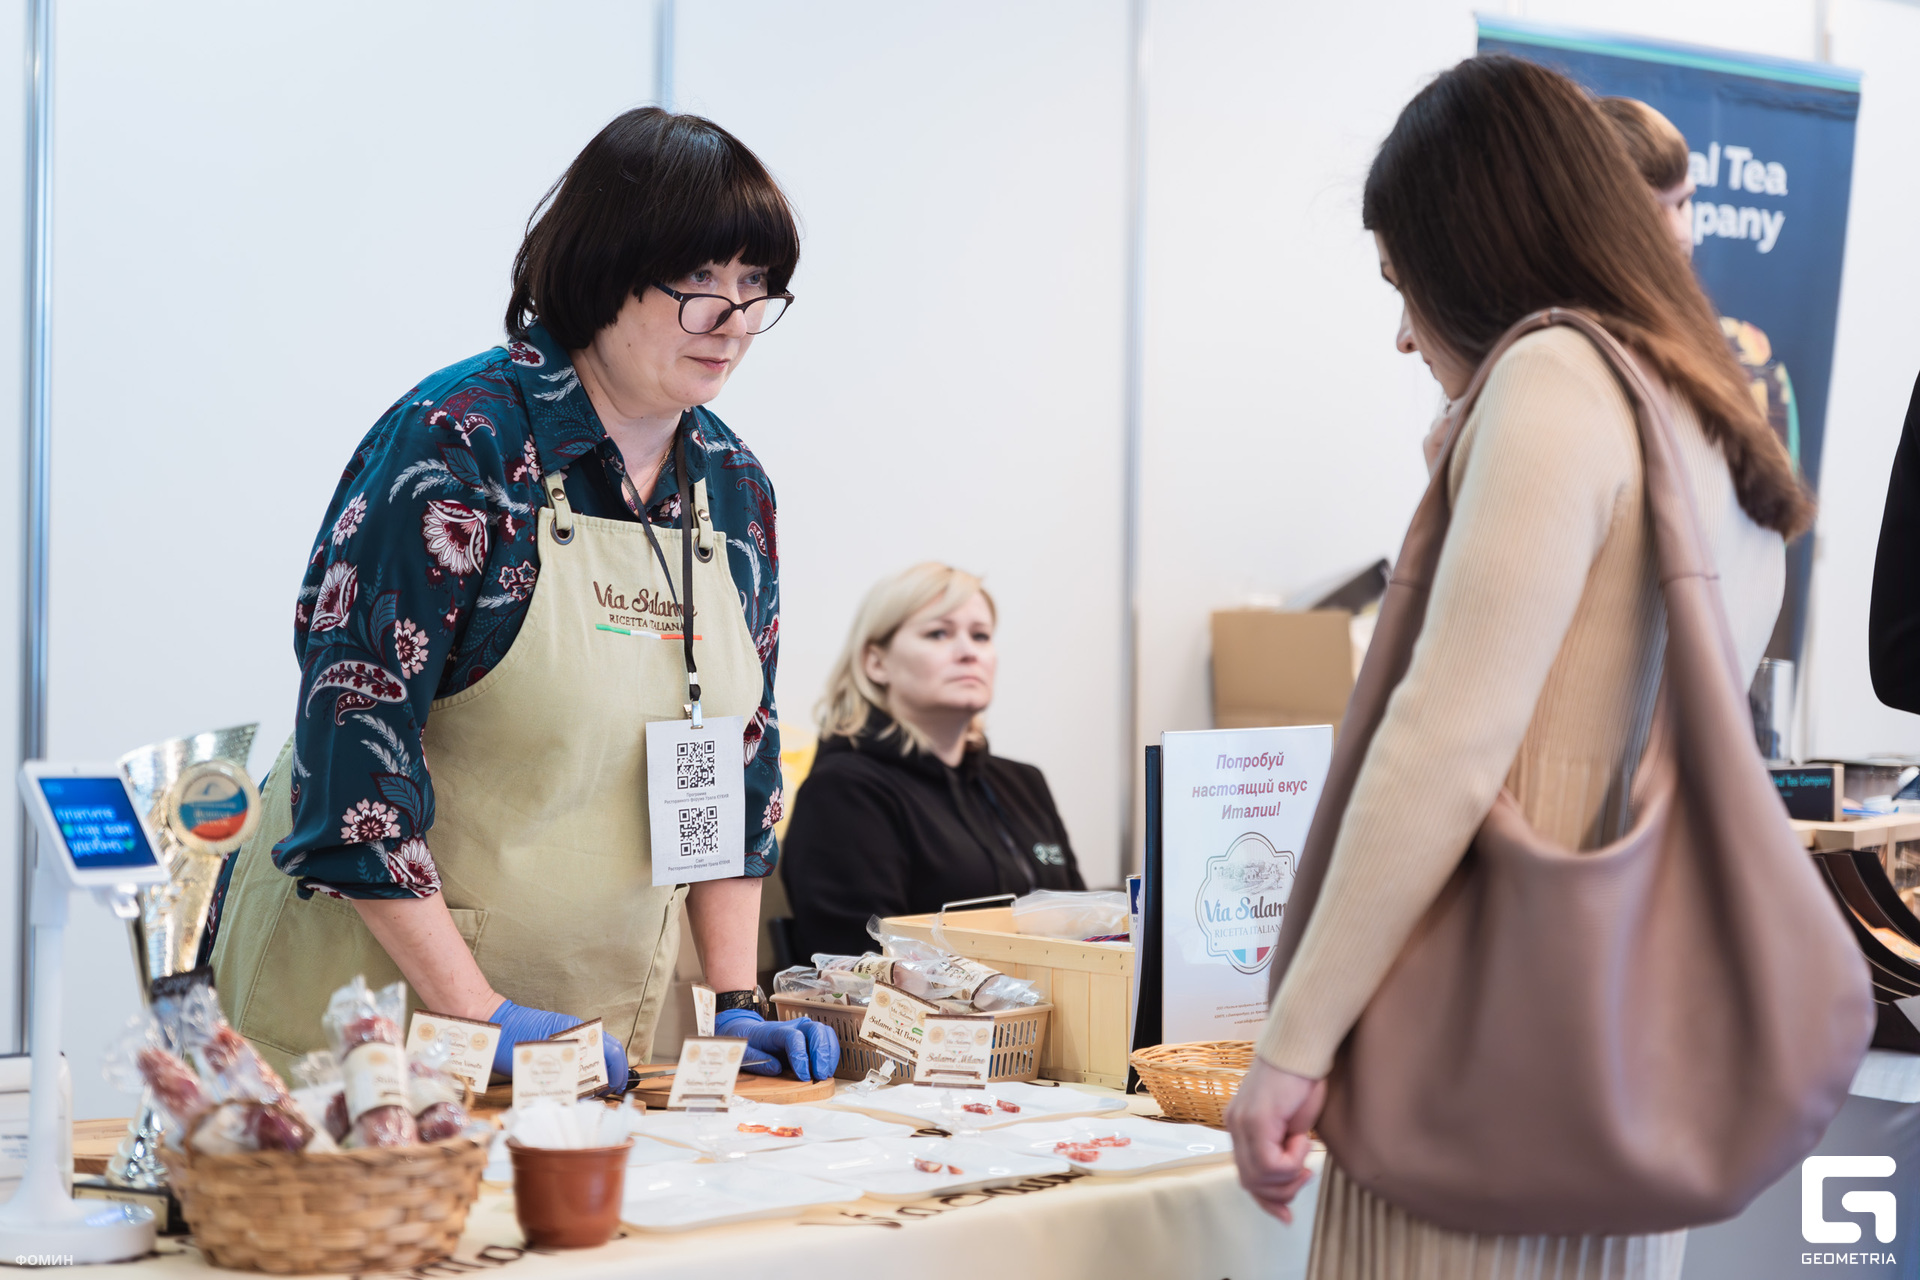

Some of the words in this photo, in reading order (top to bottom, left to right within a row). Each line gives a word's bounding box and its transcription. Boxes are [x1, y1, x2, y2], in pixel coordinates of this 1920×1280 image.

[1689, 141, 1720, 188] al
[1723, 144, 1789, 196] Tea
[1693, 201, 1786, 254] pany
[593, 581, 629, 610] Via
[609, 613, 648, 628] RICETTA
[1216, 751, 1285, 771] Попробуй
[1192, 778, 1274, 798] настоящий
[1278, 780, 1308, 796] вкус
[1221, 801, 1281, 820] Италии!
[1204, 899, 1232, 923] Via
[1235, 896, 1287, 920] Salam
[1214, 927, 1249, 938] RICETTA
[1250, 924, 1282, 935] ITALIAN
[869, 1015, 892, 1032] Salame
[925, 1052, 956, 1063] Salame
[957, 1054, 986, 1064] Milano
